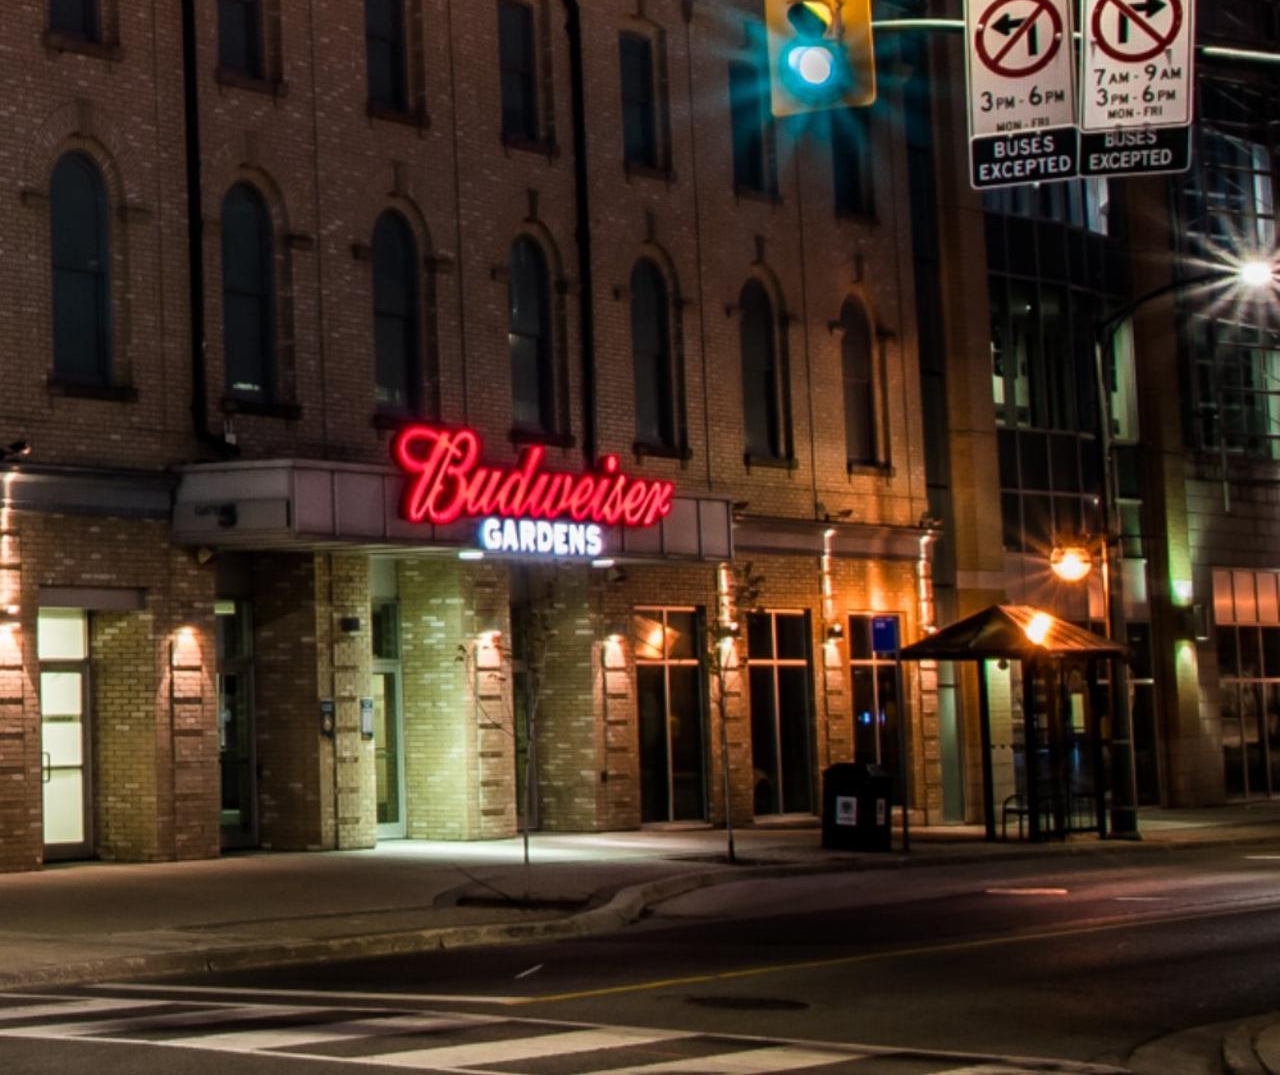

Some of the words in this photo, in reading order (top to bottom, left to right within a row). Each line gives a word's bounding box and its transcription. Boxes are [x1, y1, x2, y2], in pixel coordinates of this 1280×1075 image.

[1107, 108, 1134, 119] MON
[1143, 105, 1163, 117] FRI
[996, 119, 1023, 132] MON
[1031, 116, 1050, 128] FRI
[993, 135, 1055, 159] BUSES
[1104, 128, 1157, 148] BUSES
[978, 154, 1072, 181] EXCEPTED
[1088, 148, 1173, 171] EXCEPTED
[396, 426, 675, 525] Budweiser
[481, 517, 603, 556] GARDENS
